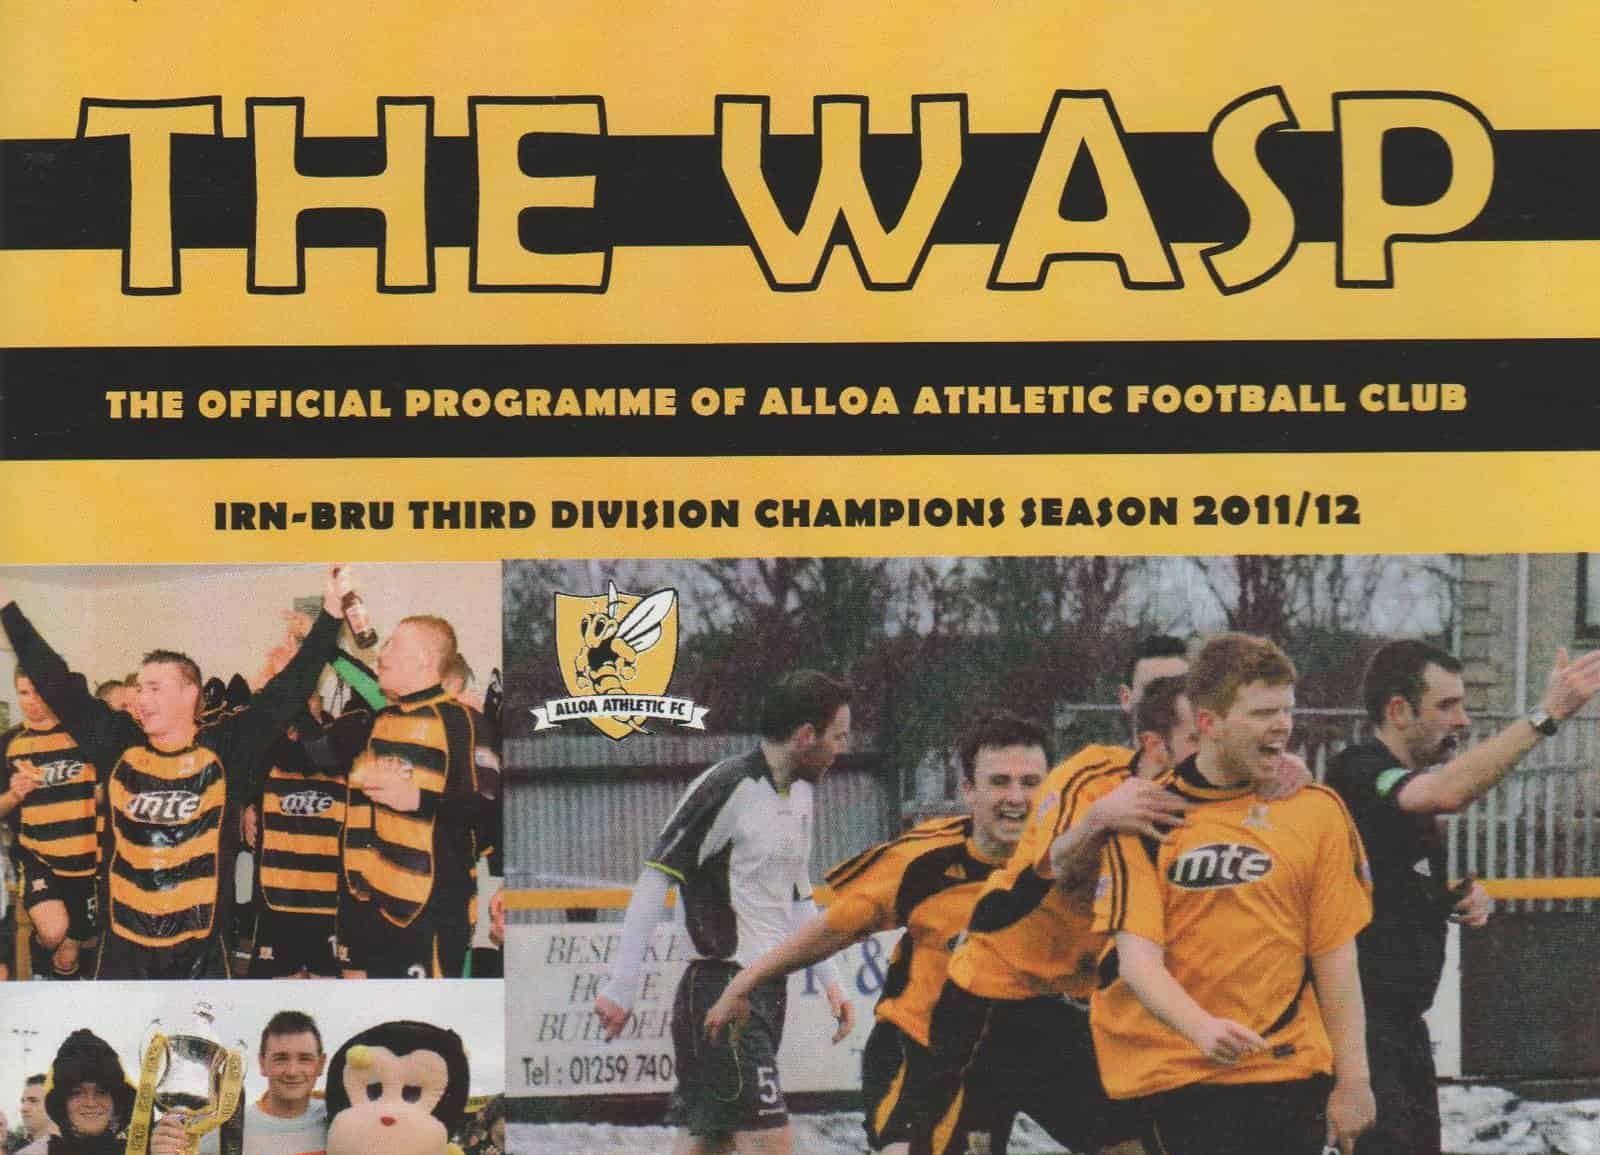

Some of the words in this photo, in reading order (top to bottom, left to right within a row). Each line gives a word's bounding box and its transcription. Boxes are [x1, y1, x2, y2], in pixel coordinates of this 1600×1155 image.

[76, 96, 612, 296] THE
[714, 85, 1497, 296] WASP
[106, 391, 183, 418] THE
[199, 390, 391, 418] OFFICIAL
[406, 388, 676, 417] PROGRAMME
[692, 388, 745, 416] OF
[760, 387, 899, 415] ALLOA
[913, 386, 1112, 414] ATHLETIC
[1128, 385, 1345, 413] FOOTBALL
[1360, 384, 1466, 411] CLUB
[215, 502, 394, 530] IRN-BRU
[408, 501, 535, 529] THIRD
[552, 500, 739, 530] DIVISION
[755, 498, 1004, 528] CHAMPIONS
[1021, 497, 1177, 528] SEASON
[1194, 491, 1360, 527] 2011/12
[556, 702, 598, 716] ALLOA
[603, 699, 665, 713] ATHLETIC
[670, 702, 686, 715] FC
[1174, 844, 1270, 882] mte
[547, 935, 694, 964] BESPKE
[522, 1056, 549, 1086] Tel
[570, 1055, 628, 1085] 01259
[758, 1067, 777, 1104] 5
